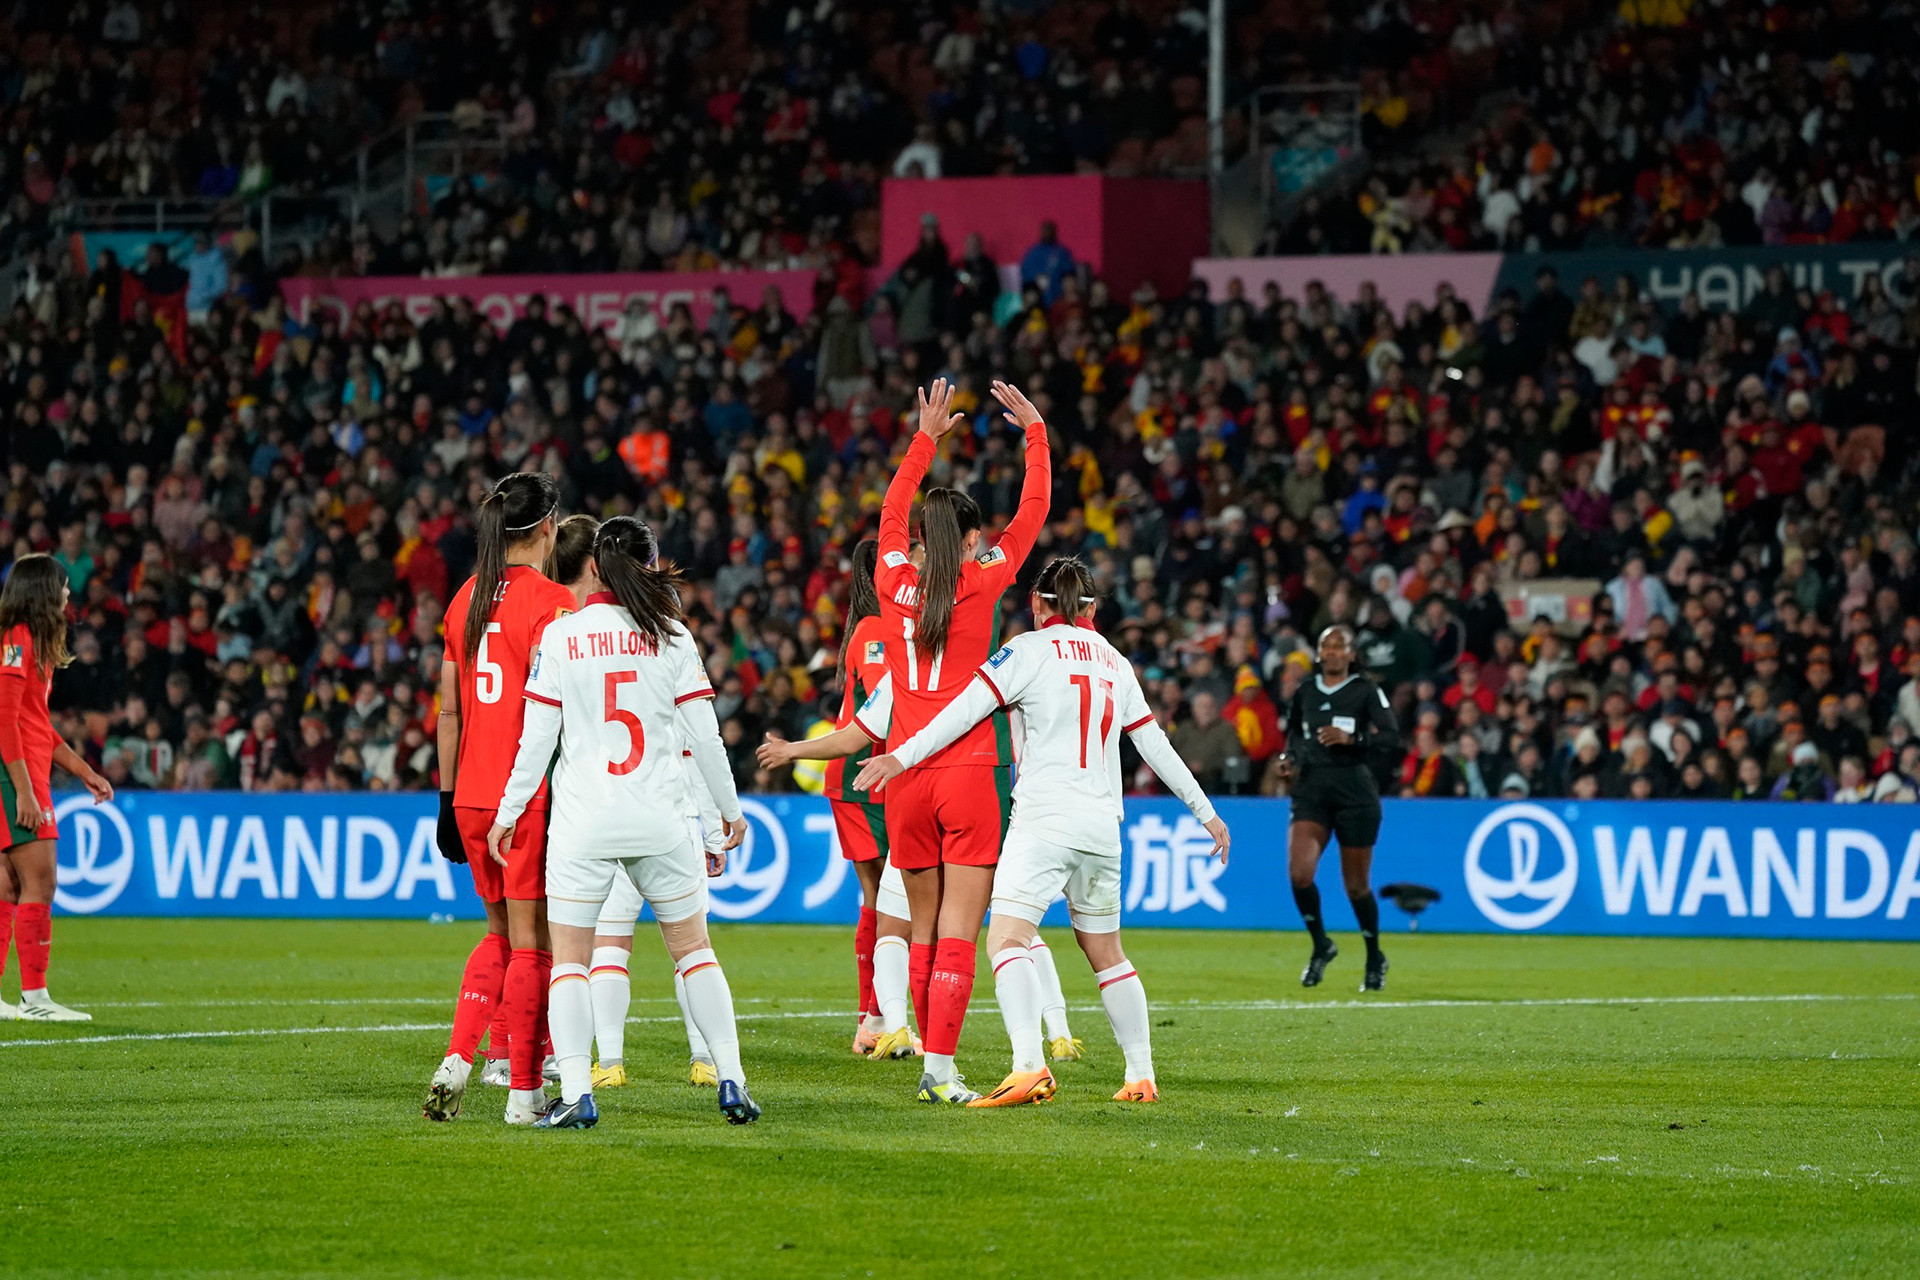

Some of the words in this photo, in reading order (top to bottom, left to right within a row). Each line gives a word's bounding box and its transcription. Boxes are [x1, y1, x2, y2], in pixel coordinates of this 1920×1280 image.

[567, 636, 584, 661] H.
[587, 631, 613, 658] THI
[1051, 639, 1068, 660] T.
[1068, 640, 1092, 661] THI
[604, 670, 645, 776] 5
[1070, 674, 1114, 769] 17
[148, 815, 456, 900] WANDA
